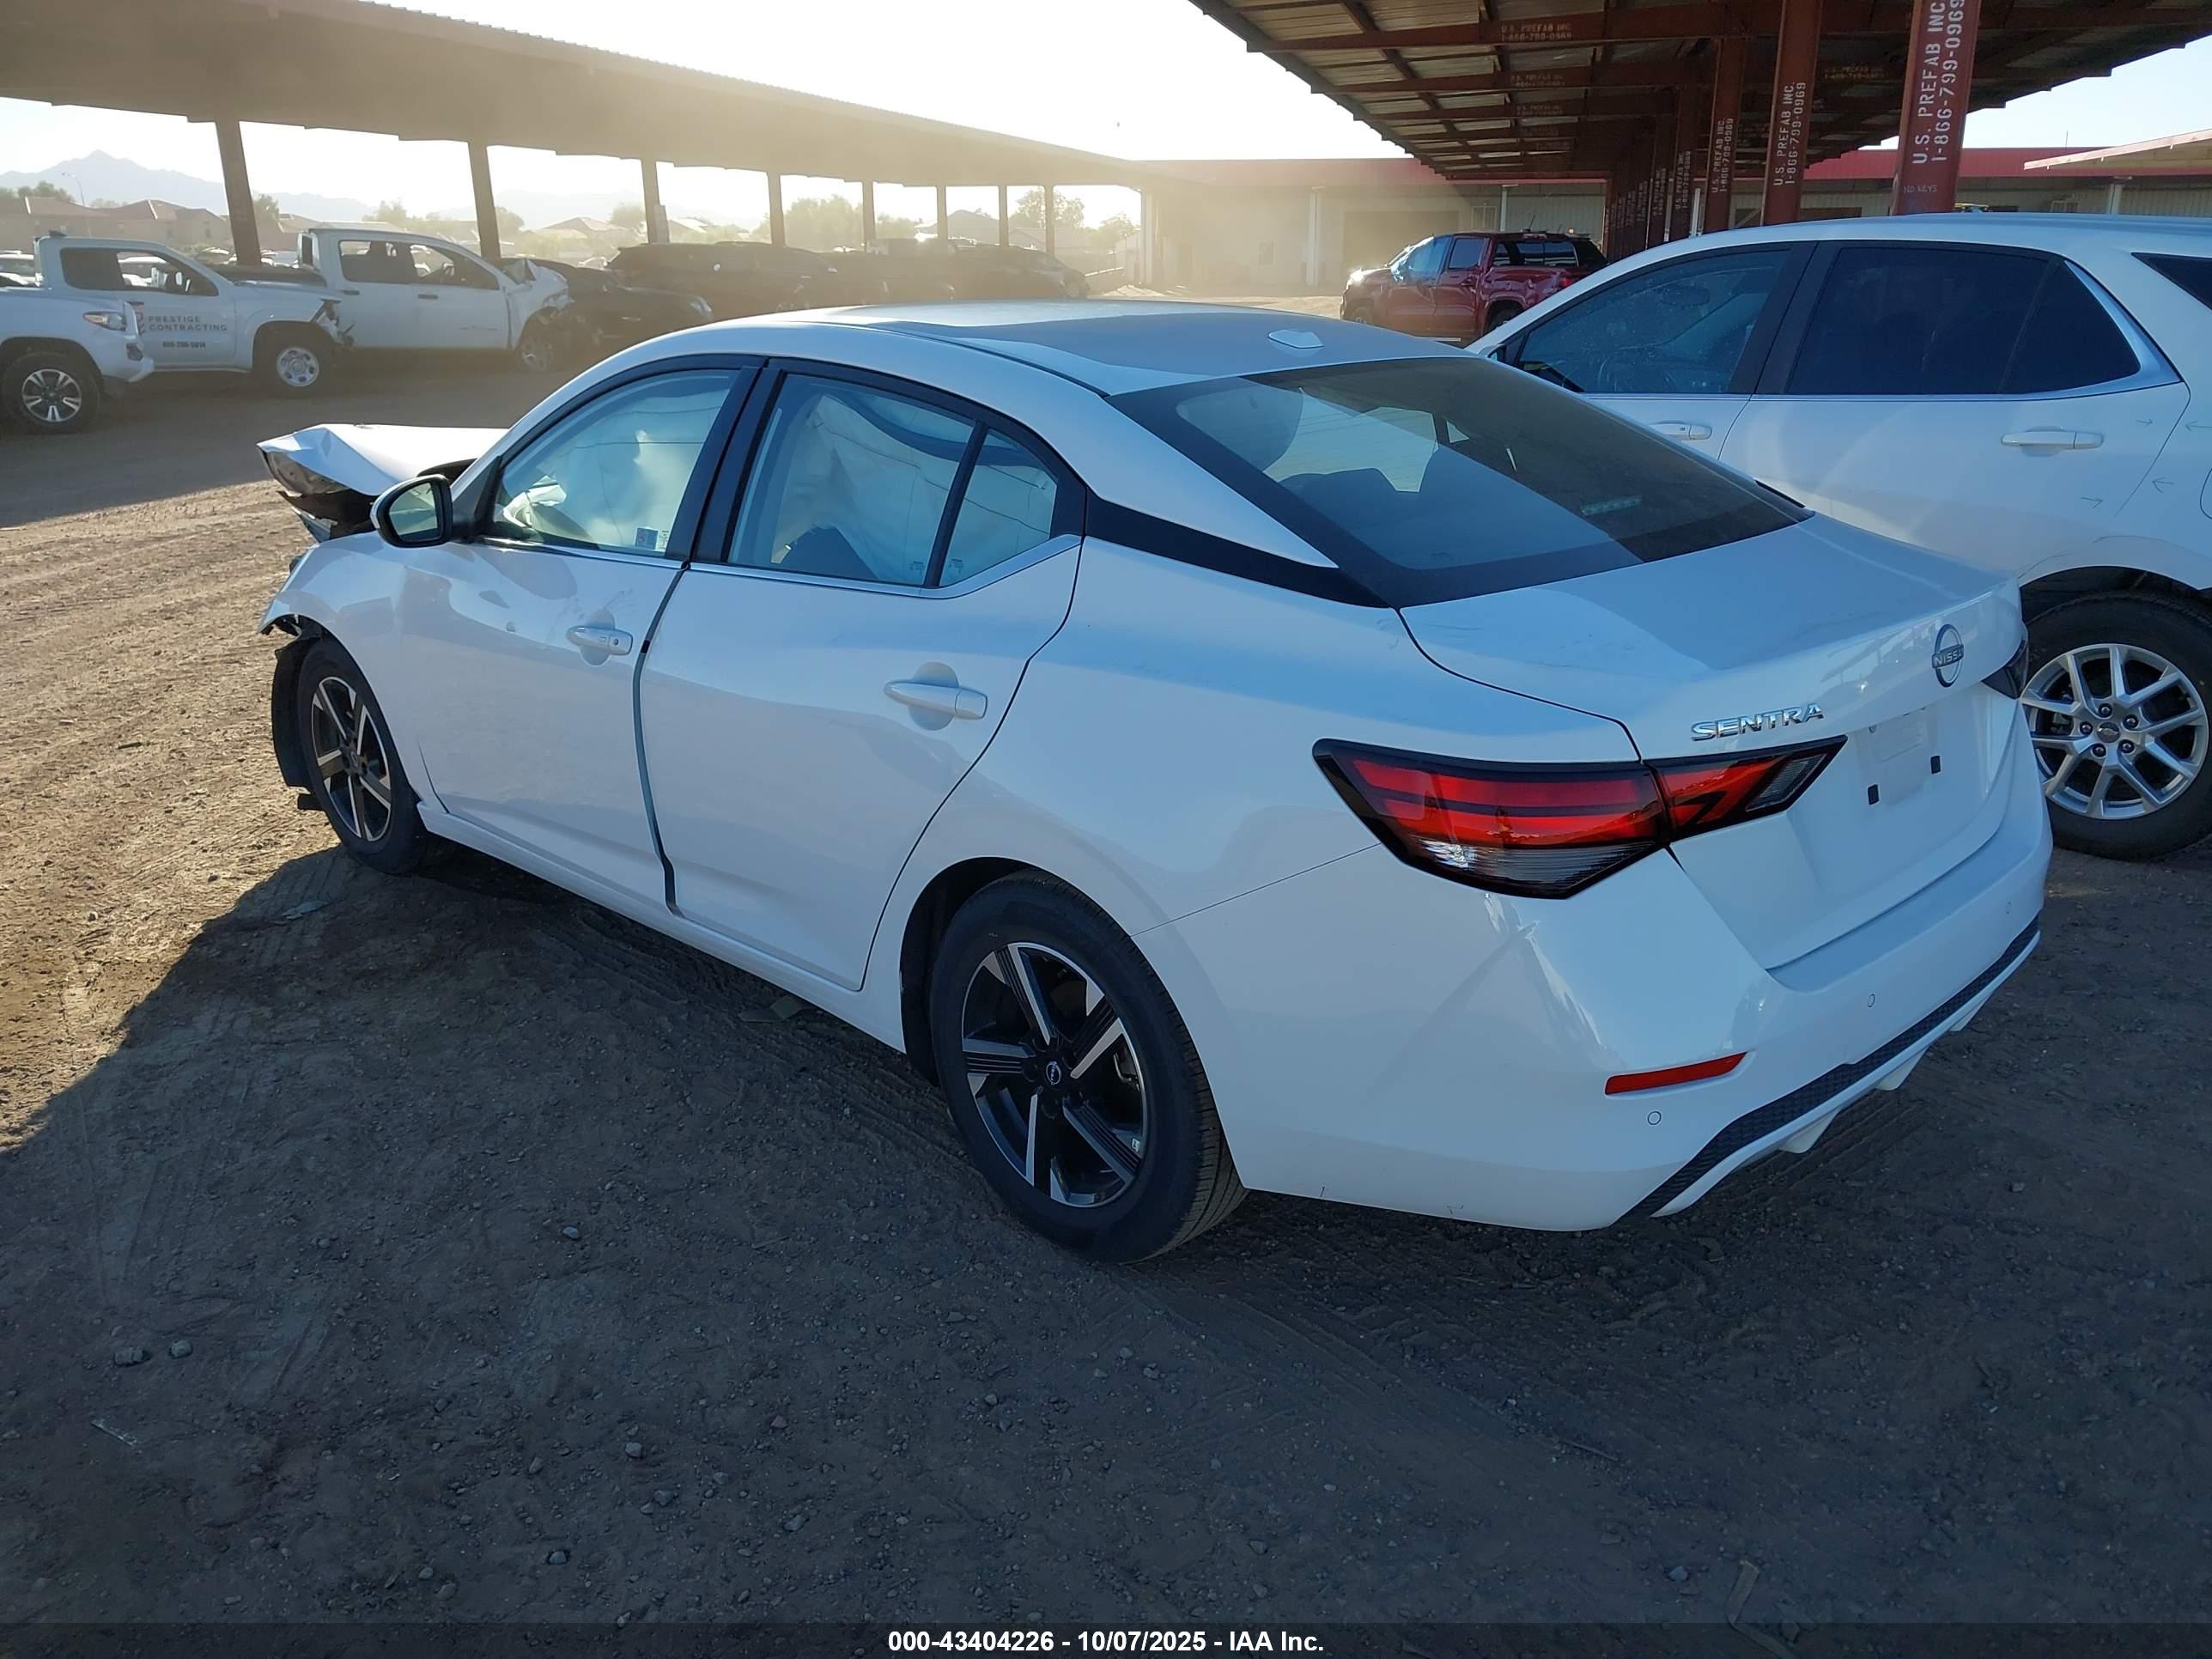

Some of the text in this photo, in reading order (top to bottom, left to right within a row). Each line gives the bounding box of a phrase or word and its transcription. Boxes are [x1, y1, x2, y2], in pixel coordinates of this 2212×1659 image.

[1917, 43, 1941, 117] PREFAB
[1931, 0, 1965, 161] 1-866-799-0969
[1777, 111, 1791, 157] PREFAB
[1785, 82, 1806, 185] 1-866-799-0969
[1911, 128, 1931, 165] U.S.
[1773, 163, 1785, 186] U.S.
[149, 315, 201, 324] PRESTIGE
[1935, 646, 1964, 666] NISSA
[1691, 702, 1824, 742] SENTRA
